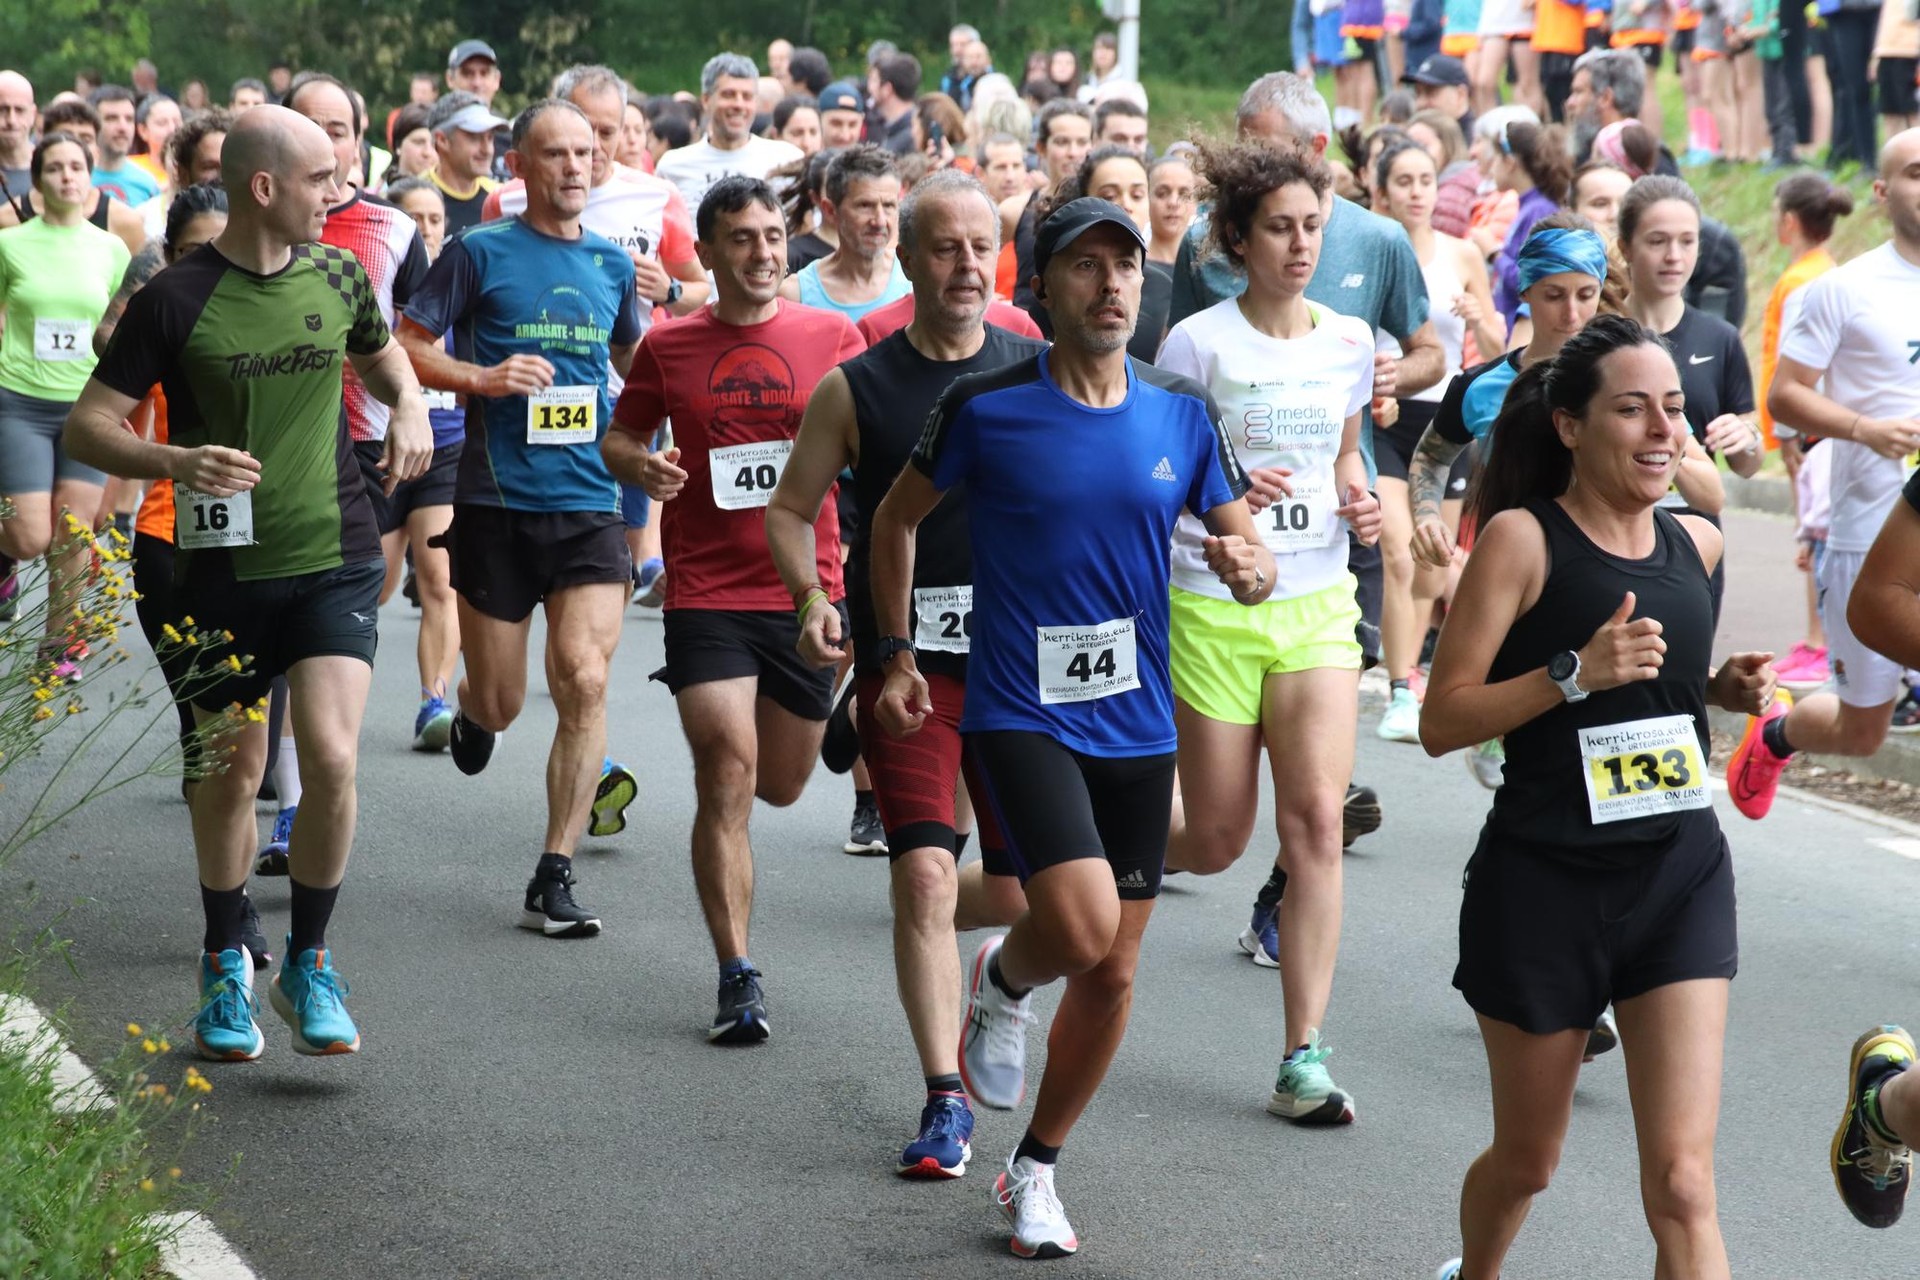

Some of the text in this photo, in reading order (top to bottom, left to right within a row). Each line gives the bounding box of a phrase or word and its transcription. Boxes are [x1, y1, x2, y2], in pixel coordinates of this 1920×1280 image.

[515, 323, 568, 340] ARRASATE
[51, 333, 76, 350] 12
[539, 406, 588, 429] 134
[1277, 404, 1327, 420] media
[714, 446, 790, 461] herrikrosa.eus
[734, 464, 777, 492] 40
[1152, 471, 1176, 481] adidas
[193, 502, 229, 532] 16
[1271, 503, 1309, 531] 10
[1043, 624, 1131, 643] herrikrosa.eus
[1076, 636, 1117, 650] URTEURRENA
[1066, 647, 1116, 683] 44
[1103, 679, 1116, 688] ON
[1117, 673, 1133, 684] LINE
[1585, 724, 1690, 748] herrikrosa.eus
[1627, 737, 1677, 752] URTEURRENA
[1603, 748, 1691, 796] 133
[1664, 790, 1682, 801] ON
[1683, 786, 1705, 798] LINE
